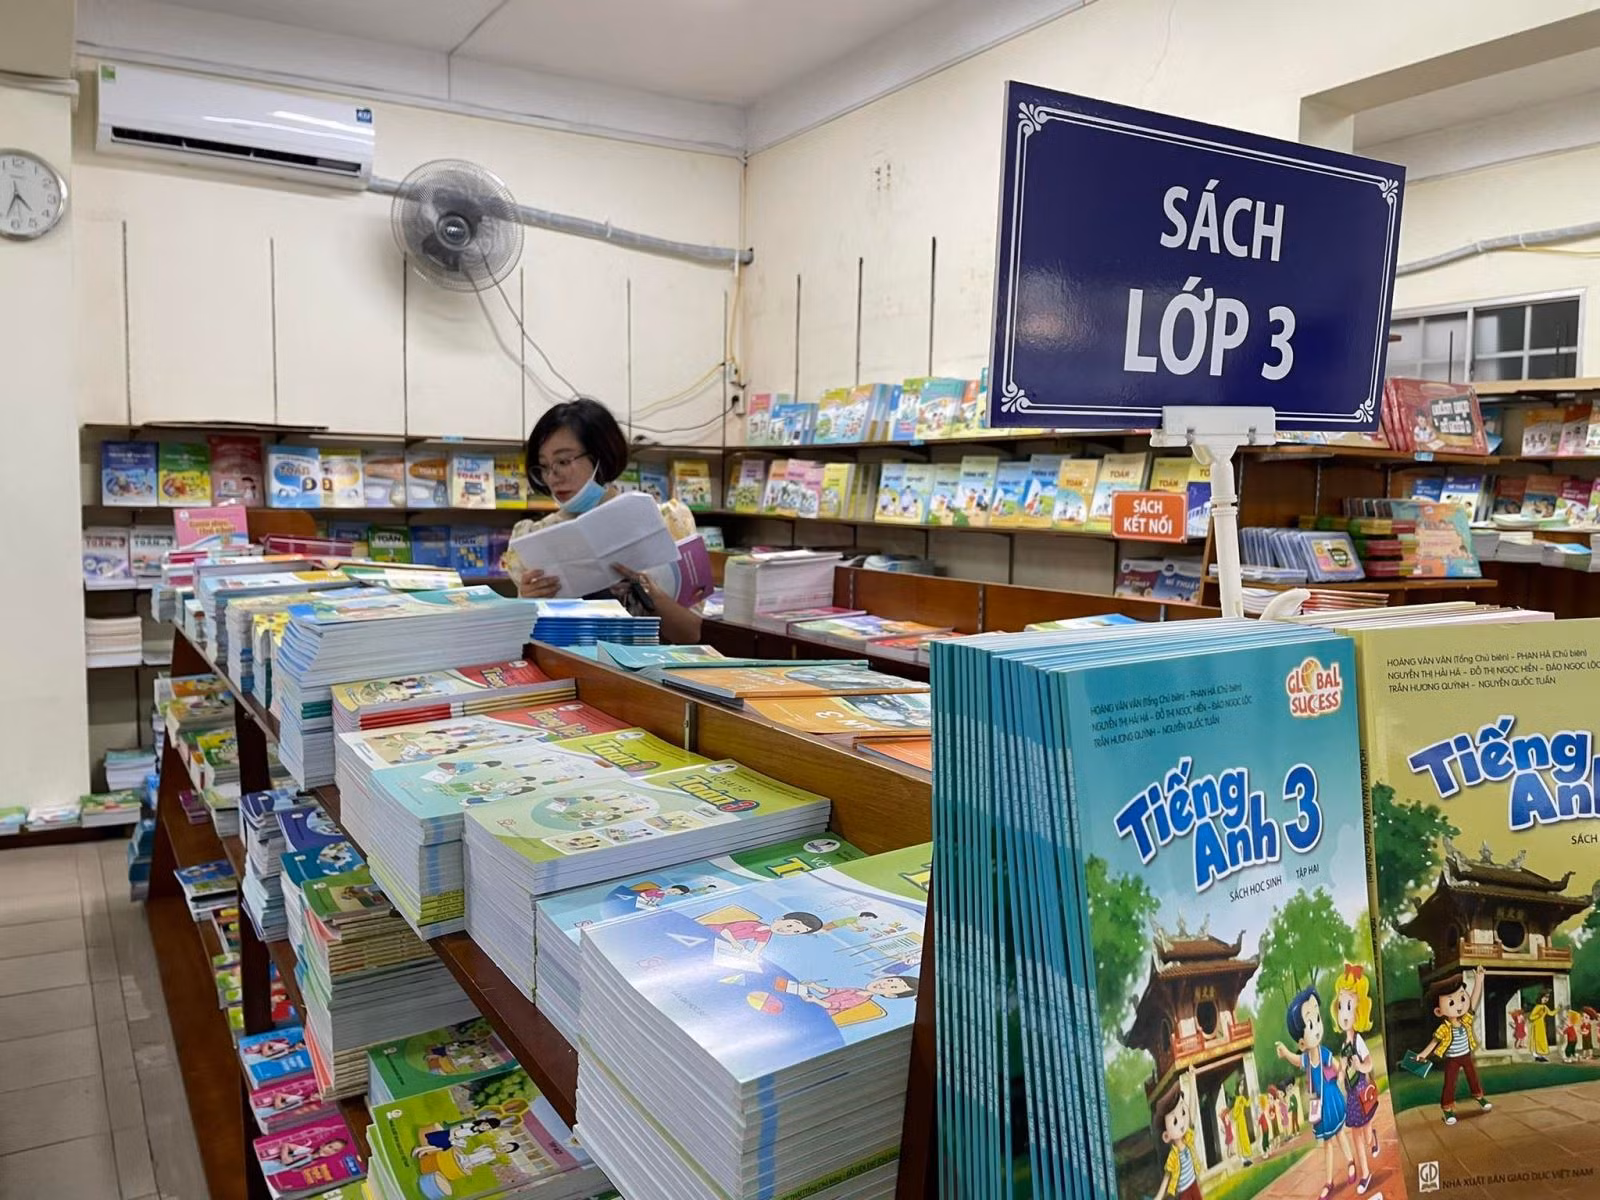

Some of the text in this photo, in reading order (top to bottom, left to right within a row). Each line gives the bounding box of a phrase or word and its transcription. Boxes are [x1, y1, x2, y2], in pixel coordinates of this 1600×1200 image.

[1160, 179, 1285, 262] SÁCH
[1124, 276, 1296, 380] LỚP 3
[1123, 513, 1173, 535] KẾT NỐI
[1133, 497, 1163, 515] SÁCH
[1407, 715, 1592, 798] Tiếng
[1114, 756, 1248, 864] Tiếng
[1195, 763, 1322, 893] Anh 3
[1571, 832, 1598, 845] SÁCH
[1249, 880, 1265, 896] HỌC
[1266, 875, 1282, 890] SINH
[1295, 867, 1307, 881] TẬP
[1308, 863, 1320, 875] HAI
[1420, 1163, 1438, 1182] GD
